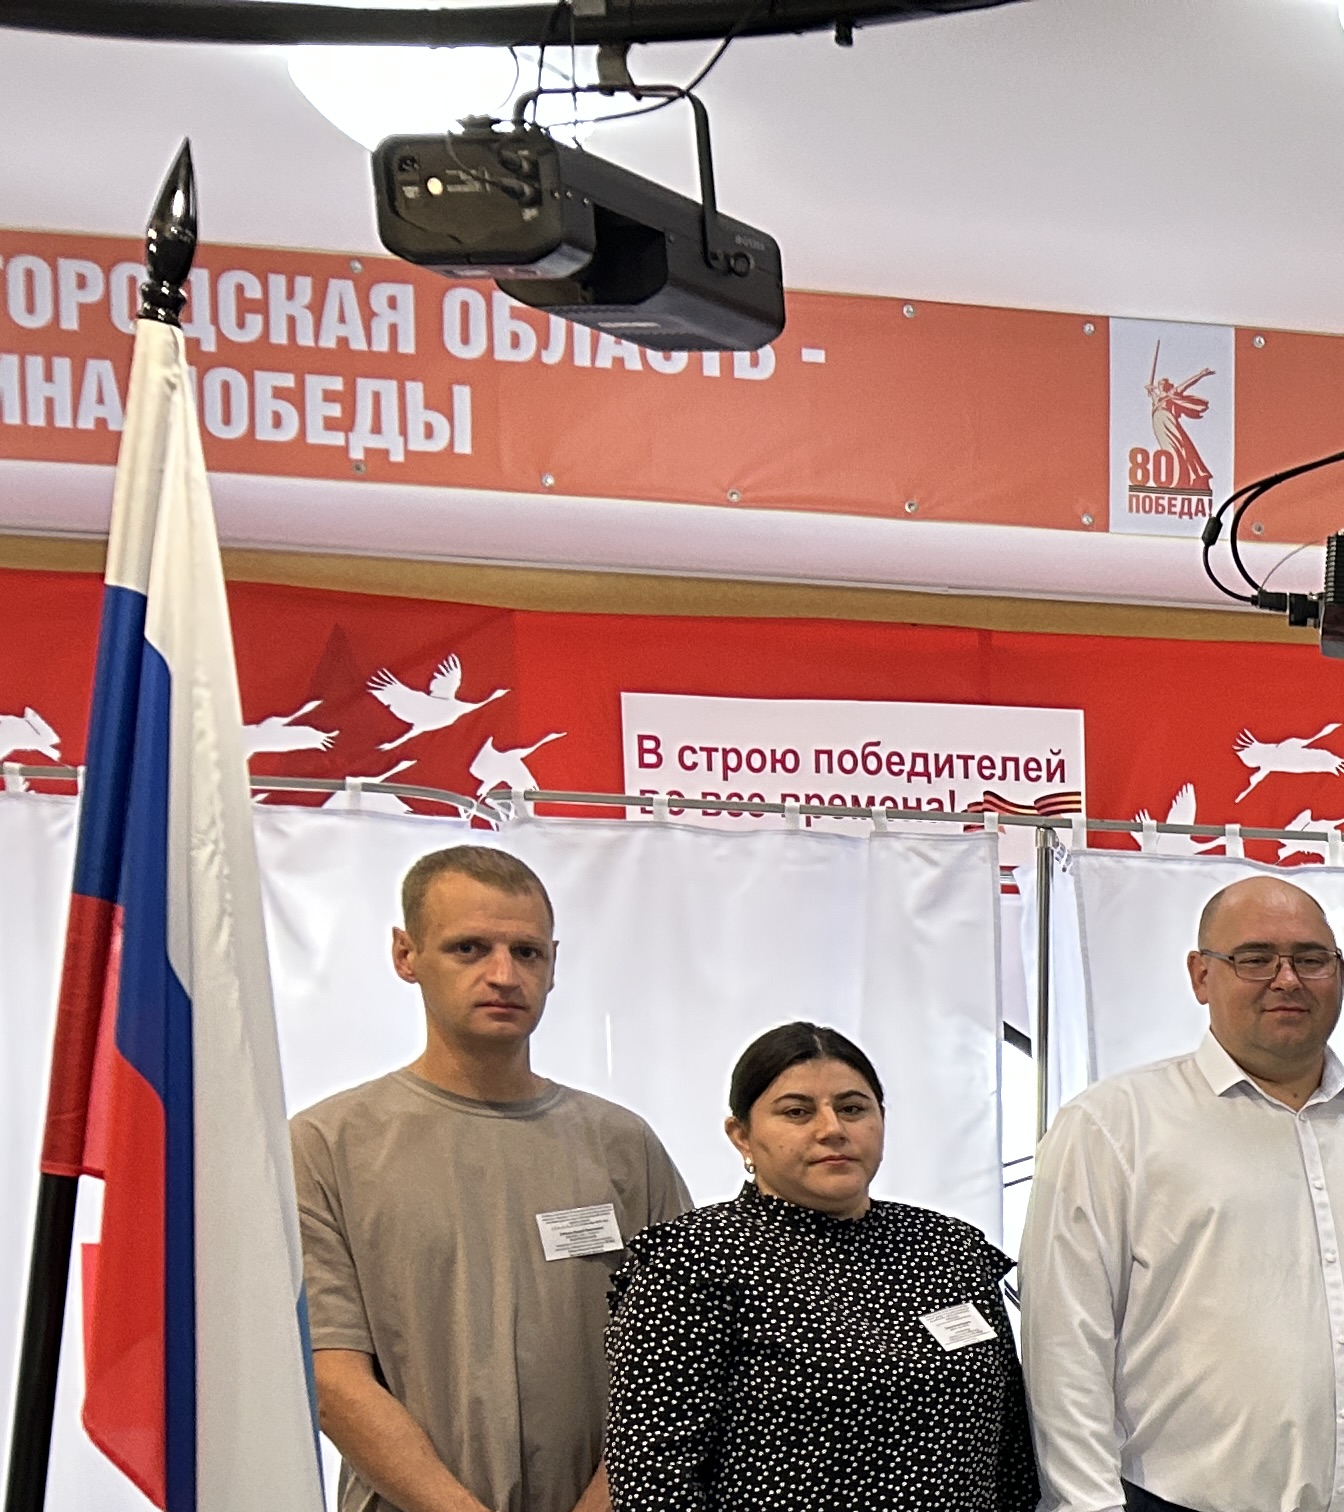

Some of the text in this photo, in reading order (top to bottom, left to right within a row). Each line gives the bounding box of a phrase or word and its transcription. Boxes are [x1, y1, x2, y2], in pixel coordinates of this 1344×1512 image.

[0, 254, 416, 355] ОРОДСКАЯ
[442, 287, 776, 381] ОБЛАЬ
[187, 365, 472, 461] ОБЕДЫ
[1129, 448, 1175, 488] 80
[1128, 494, 1213, 520] ПОБЕДА!
[637, 734, 1066, 784] В строю победителей
